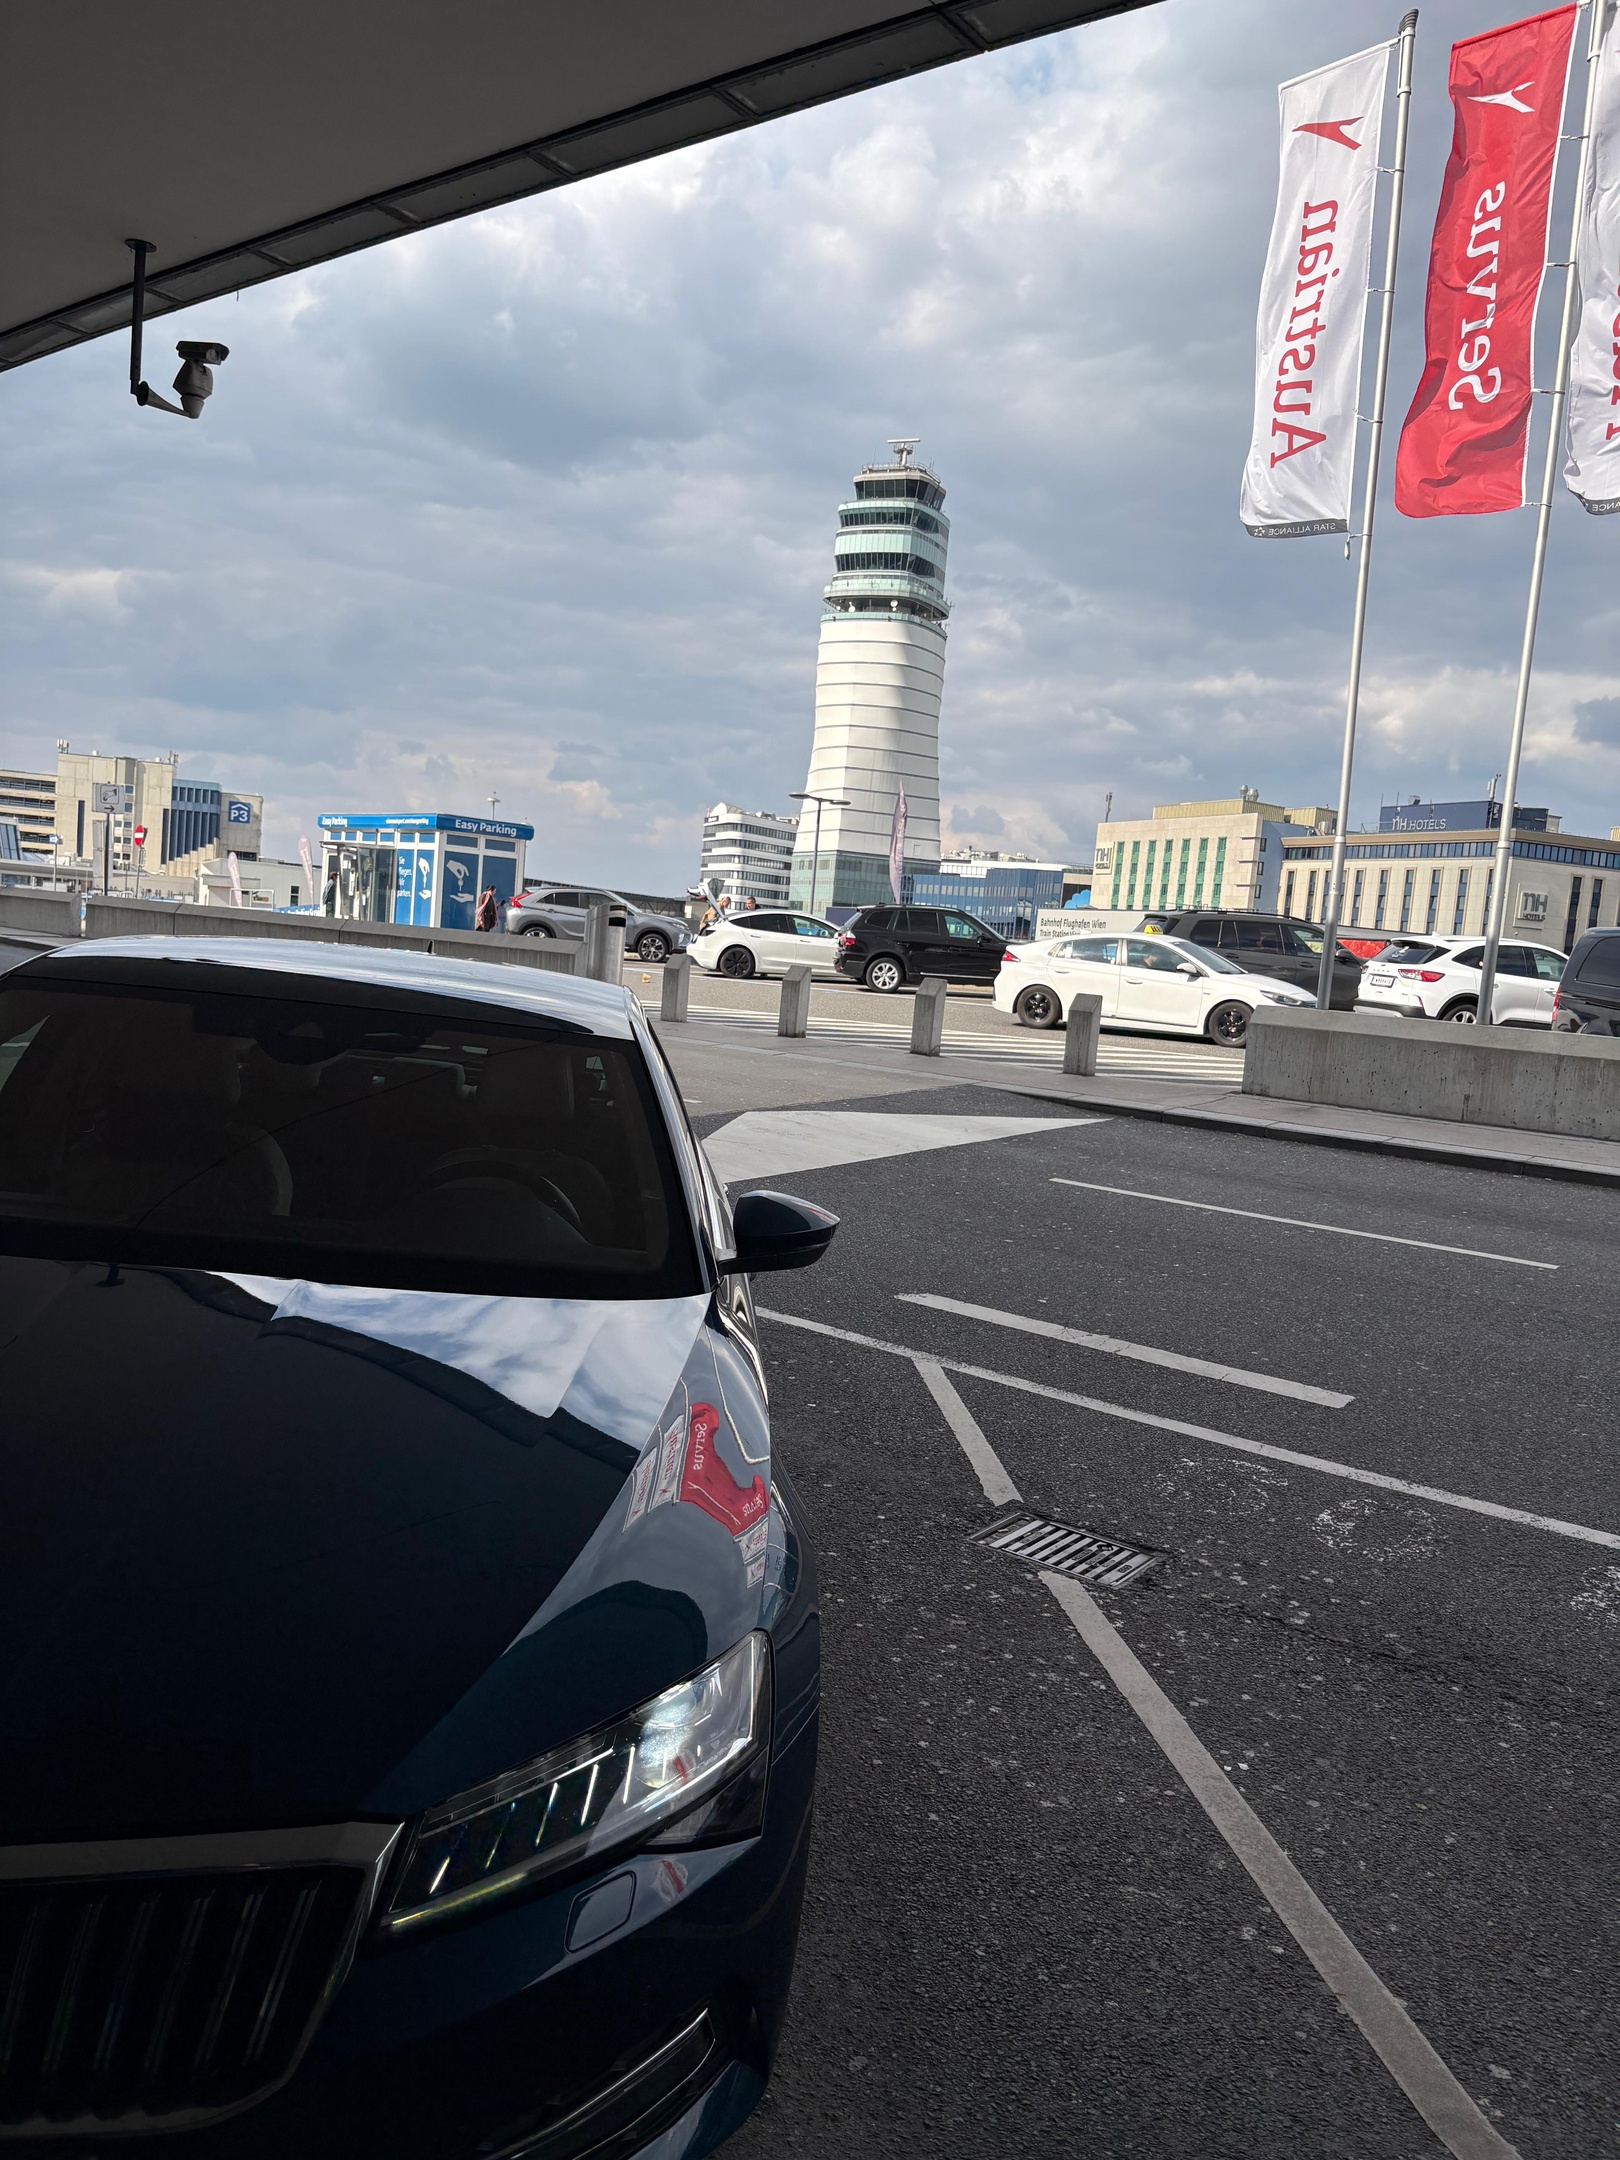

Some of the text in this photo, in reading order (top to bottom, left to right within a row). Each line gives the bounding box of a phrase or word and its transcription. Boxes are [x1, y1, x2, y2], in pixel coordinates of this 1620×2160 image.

[230, 809, 248, 822] P3
[455, 819, 517, 838] Easy Parking
[1409, 818, 1447, 830] HOTELS
[1040, 917, 1107, 929] Bahnhof Flughafen Wien
[1039, 929, 1051, 937] Train
[1052, 929, 1070, 938] Station
